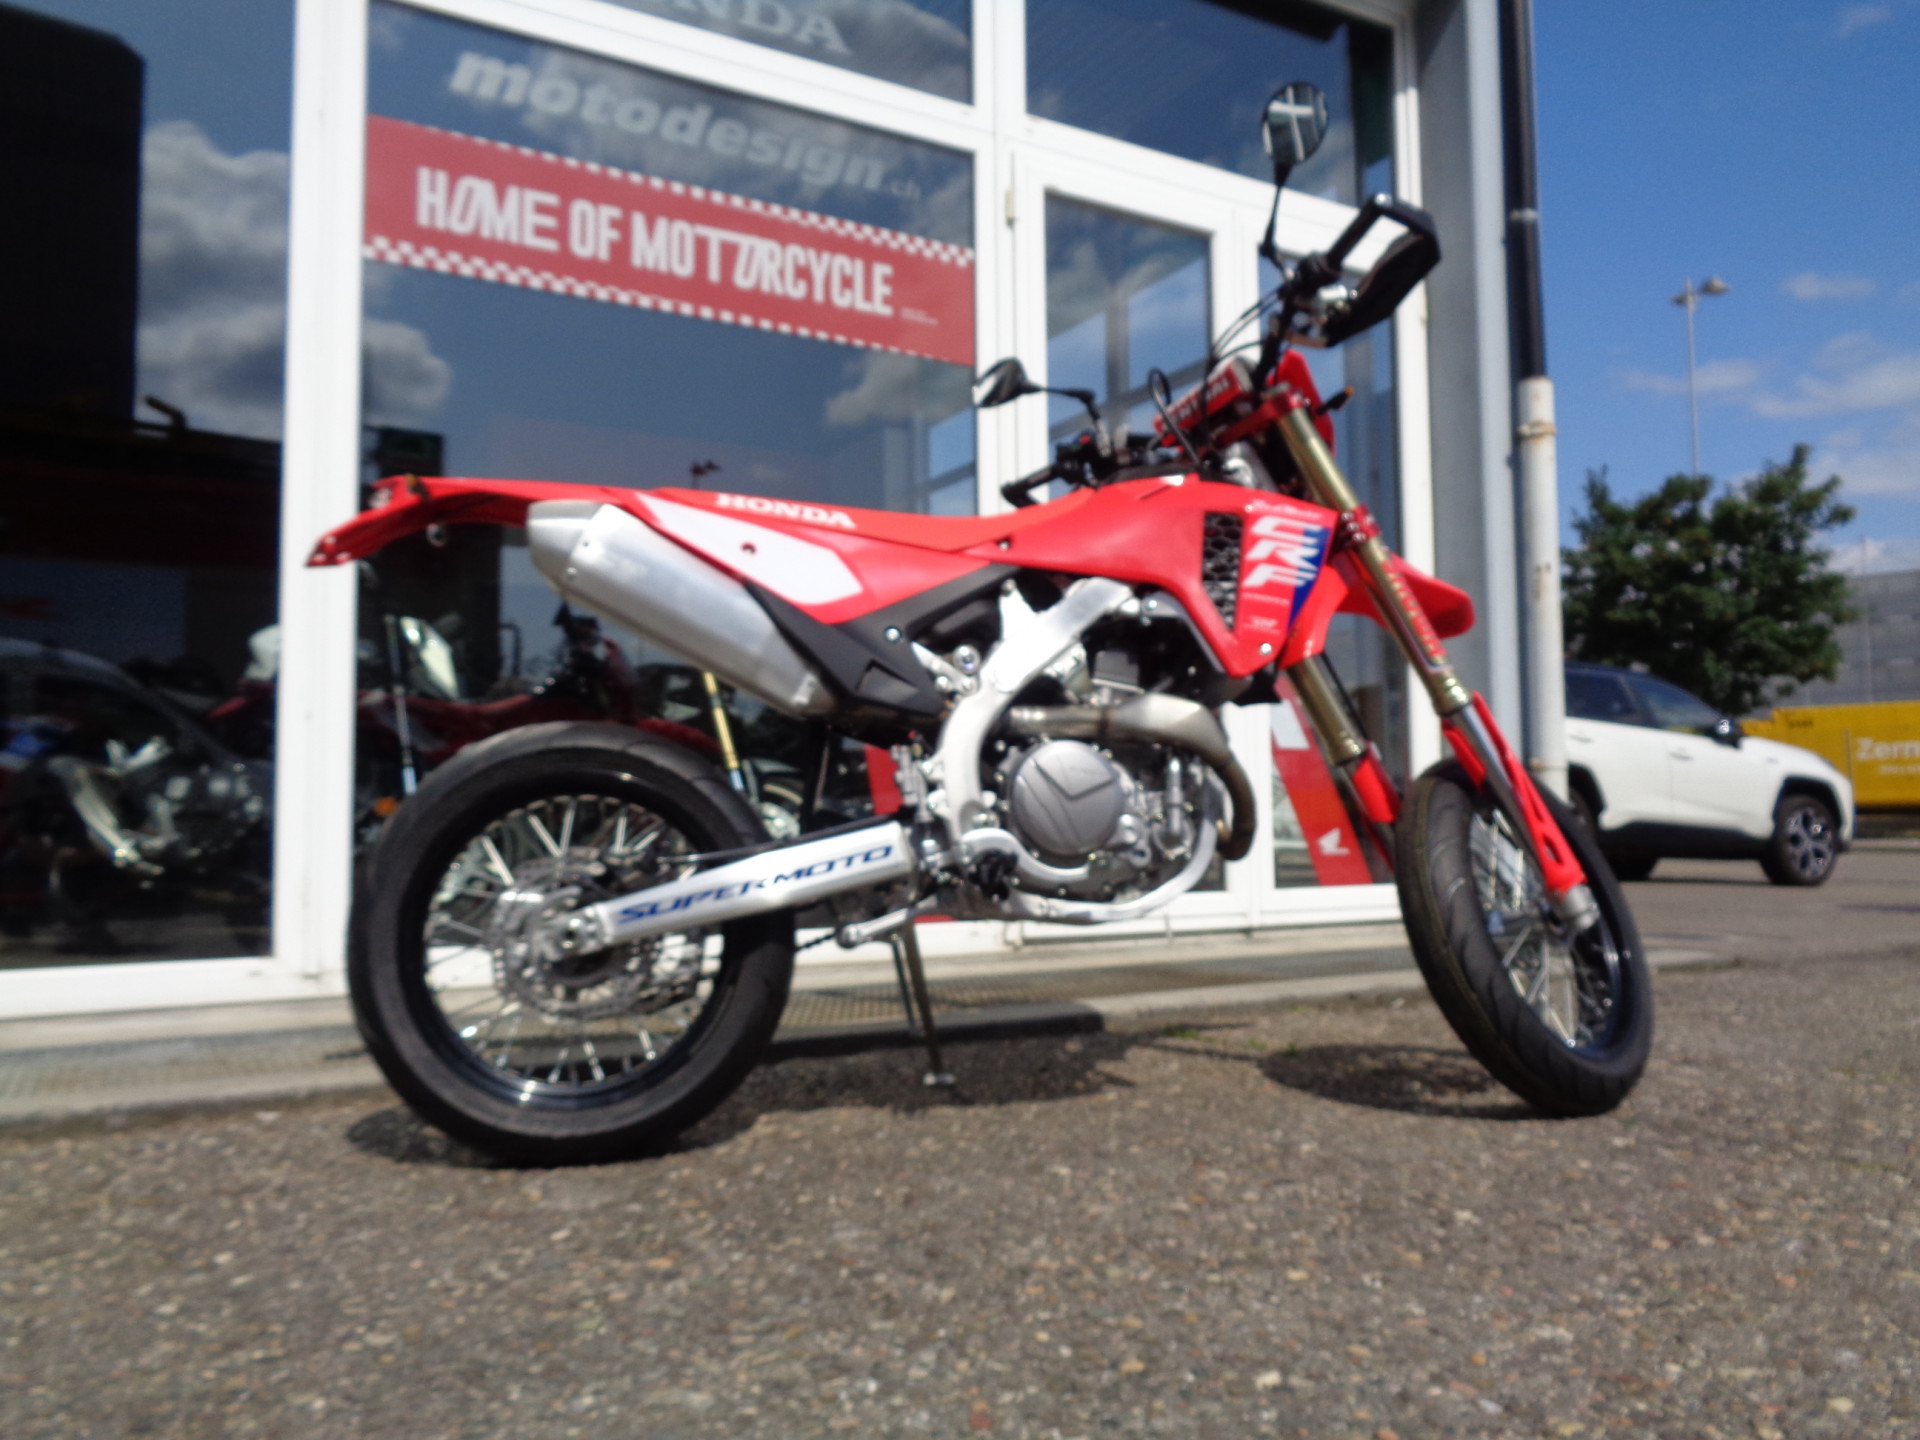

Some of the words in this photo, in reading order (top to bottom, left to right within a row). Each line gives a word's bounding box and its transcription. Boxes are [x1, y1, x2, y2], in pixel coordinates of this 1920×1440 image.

[416, 165, 561, 252] HOME
[568, 197, 623, 261] OF
[630, 210, 895, 317] MOTORCYCLE
[716, 492, 857, 529] HONDA
